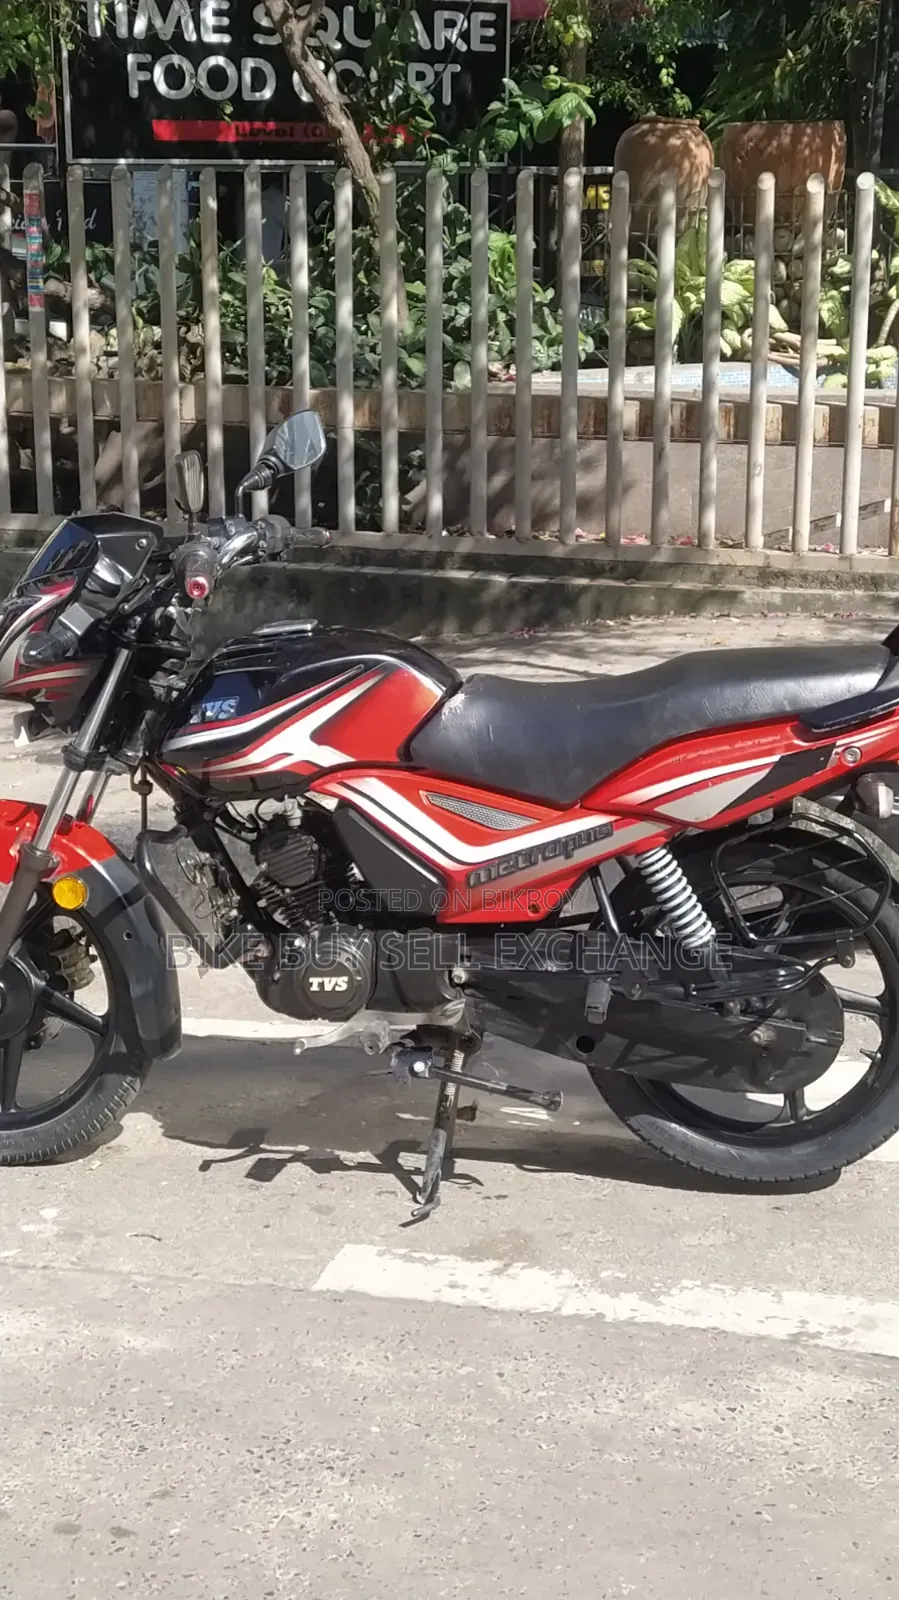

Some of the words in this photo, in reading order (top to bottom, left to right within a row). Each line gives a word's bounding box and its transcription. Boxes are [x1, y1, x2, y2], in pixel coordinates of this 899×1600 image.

[84, 0, 232, 43] TIME
[127, 53, 277, 101] FOOD
[292, 59, 461, 106] CORT
[308, 976, 349, 992] TVS
